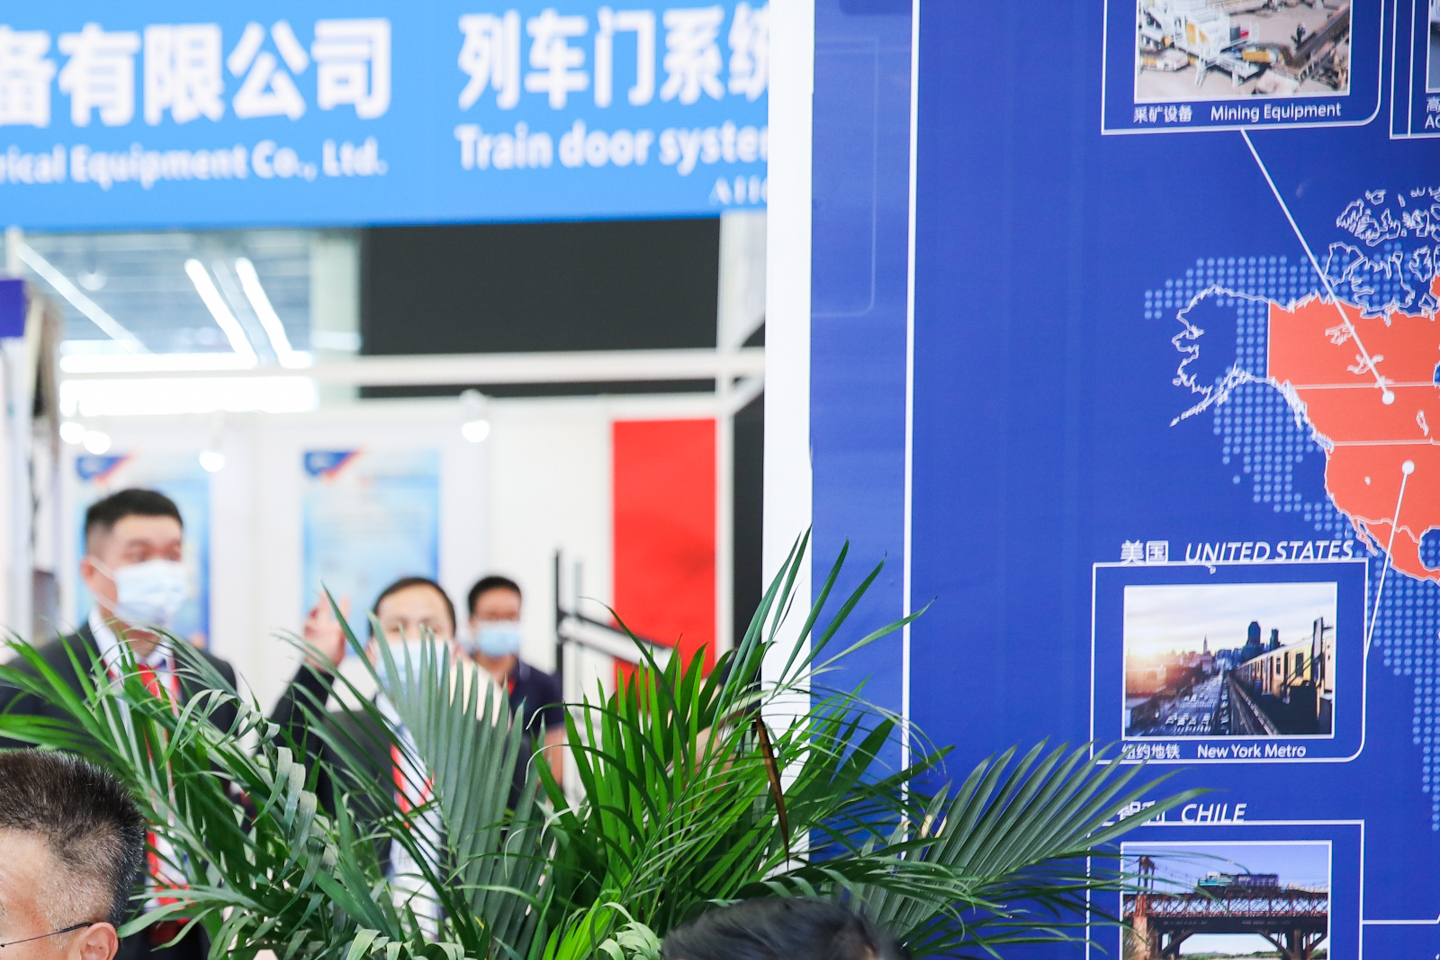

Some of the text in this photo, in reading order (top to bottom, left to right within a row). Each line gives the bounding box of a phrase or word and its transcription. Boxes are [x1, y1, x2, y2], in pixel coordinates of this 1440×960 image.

[1133, 102, 1342, 124] 采矿设备 Mining Equipment
[455, 119, 768, 176] Train door syste
[70, 141, 248, 190] Equipment
[251, 139, 318, 182] Co.,
[322, 136, 388, 178] Ltd.
[1120, 539, 1355, 564] 美国 UNITED STATES
[1197, 744, 1229, 758] New
[1231, 743, 1262, 758] York
[1264, 743, 1307, 758] Metro
[1181, 803, 1247, 824] CHILE
